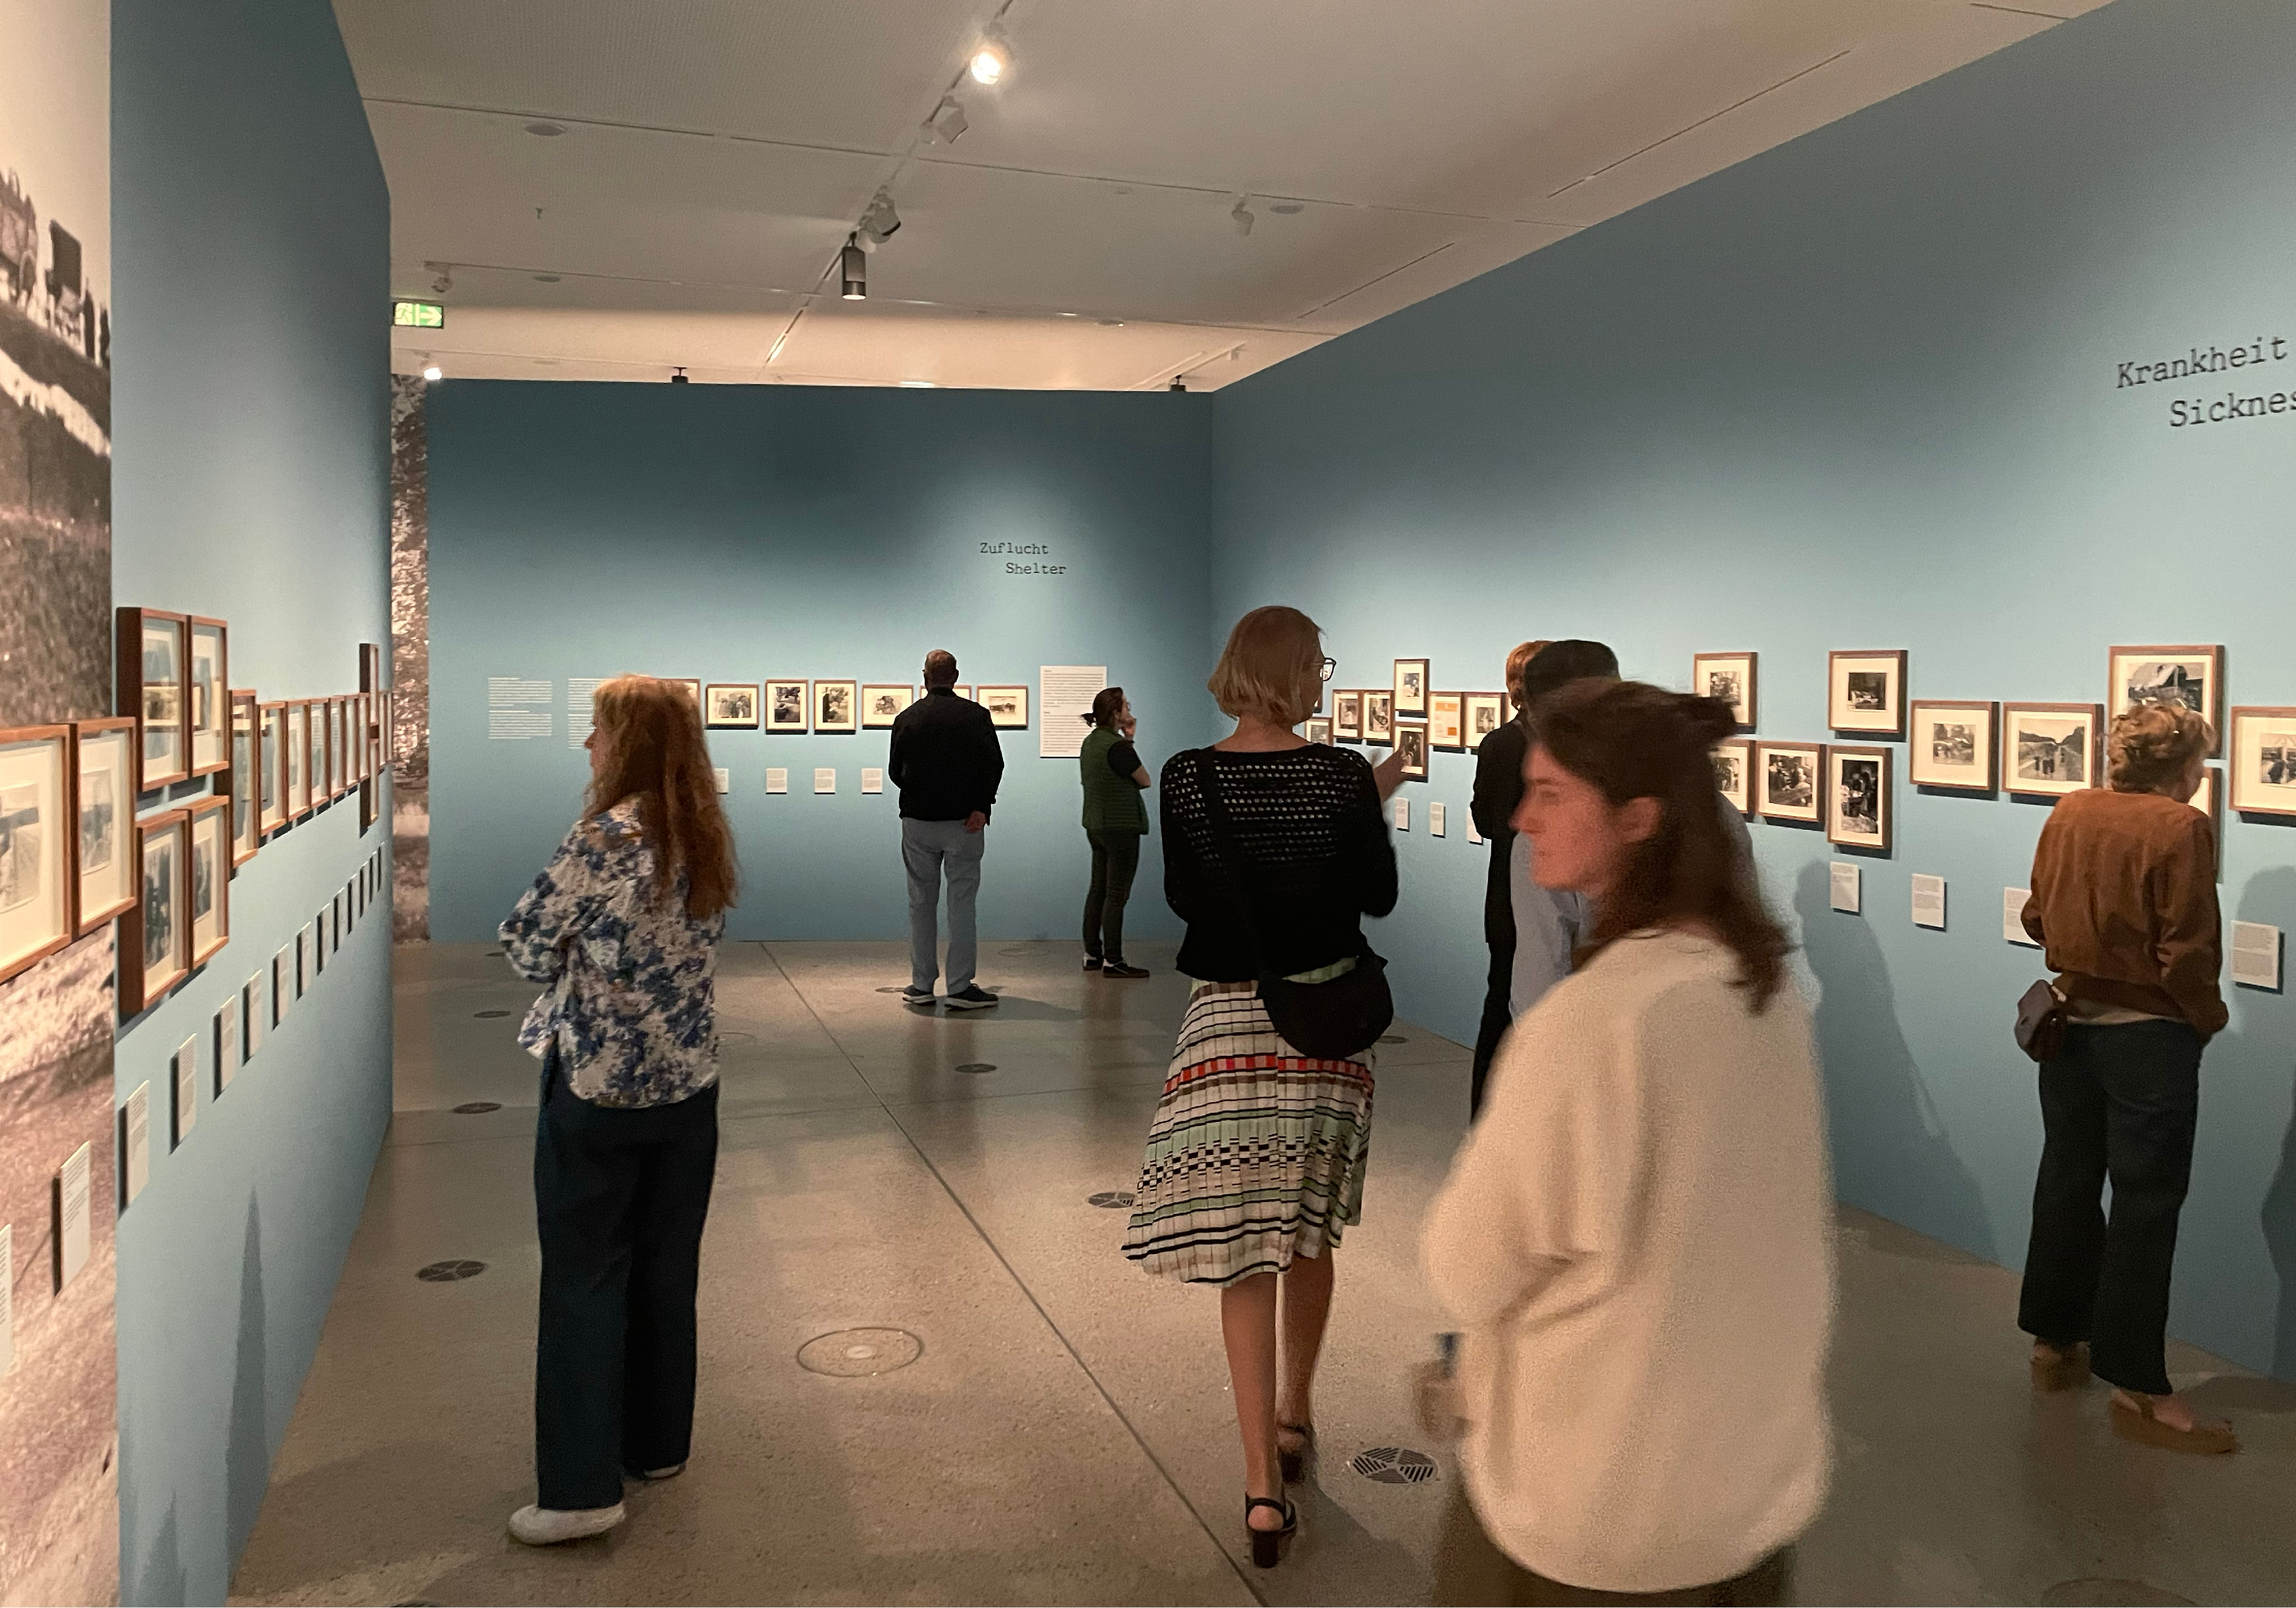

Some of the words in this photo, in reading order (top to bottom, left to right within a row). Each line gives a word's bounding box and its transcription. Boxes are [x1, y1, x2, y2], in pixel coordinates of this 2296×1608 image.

[2117, 336, 2287, 388] Krankheit
[980, 542, 1049, 554] Zuflucht
[1006, 562, 1067, 574] Shelter
